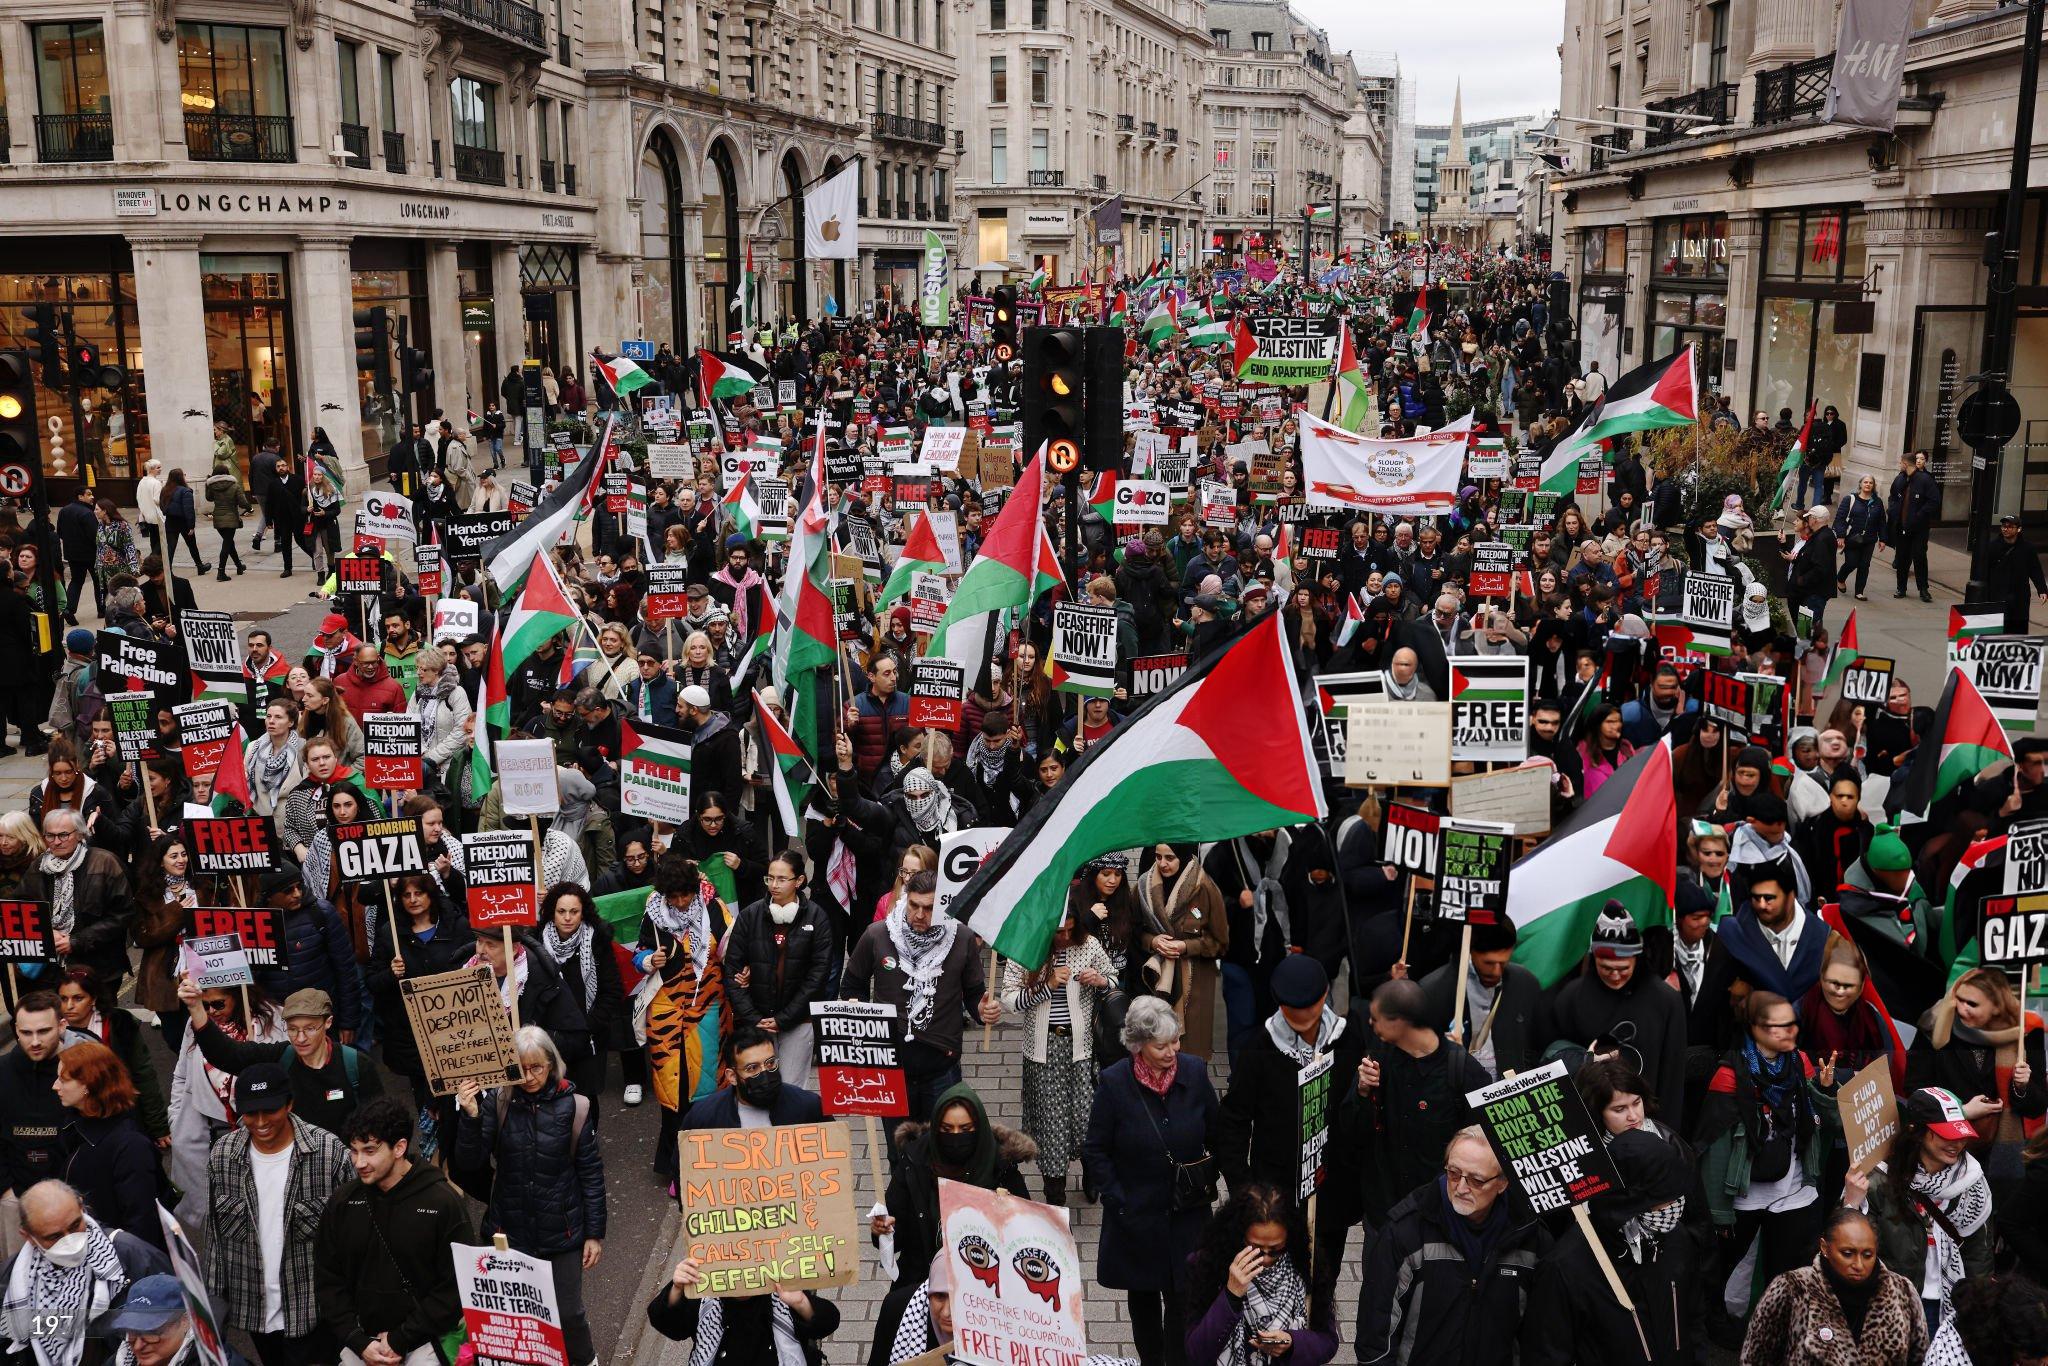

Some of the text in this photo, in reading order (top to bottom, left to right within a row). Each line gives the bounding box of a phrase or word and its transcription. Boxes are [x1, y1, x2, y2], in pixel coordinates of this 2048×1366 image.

[1840, 39, 1899, 81] H&M
[117, 191, 146, 199] HANOVER
[118, 199, 141, 207] STREET
[160, 194, 331, 212] LONGCHAMP
[400, 202, 450, 220] LONGCHAMP
[925, 247, 943, 324] UNISON
[1253, 318, 1326, 337] FREE
[1257, 338, 1329, 358] PALESTINE
[1250, 363, 1331, 378] END APARTHEID
[1177, 402, 1195, 411] Free
[880, 445, 910, 453] PALESTINE
[931, 440, 953, 448] IT BE
[848, 454, 862, 463] Off
[863, 460, 883, 469] FREEDOM
[983, 452, 1007, 463] Silence
[830, 465, 858, 474] Yemen
[606, 478, 627, 488] FREEDOM
[896, 484, 928, 499] FREE
[1392, 495, 1416, 503] POWER
[1116, 508, 1130, 516] Stop
[1278, 505, 1309, 522] GAZA
[368, 520, 380, 528] Stop
[447, 520, 511, 536] Hands Off
[1303, 528, 1339, 549] FREE
[1302, 548, 1338, 559] PALESTINE
[1476, 550, 1509, 560] FREEDOM
[340, 559, 382, 581] FREE
[650, 570, 683, 581] FREEDOM
[1473, 562, 1509, 572] PALESTINE
[341, 580, 382, 591] PALESTINE
[648, 583, 685, 594] PALESTINE
[1686, 579, 1733, 600] CEASEFIRE
[1689, 598, 1728, 622] NOW!
[183, 619, 236, 641] CEASEFIRE
[1056, 611, 1115, 636] CEASEFIRE
[119, 639, 157, 664] Free
[191, 638, 237, 664] NOW!
[1062, 629, 1109, 660] NOW!
[101, 653, 177, 686] Palestine
[916, 666, 959, 681] FREEDOM
[913, 683, 961, 699] PALESTINE
[111, 700, 150, 712] FROM THE
[181, 700, 220, 712] Socialist Worker
[113, 710, 148, 721] RIVER TO
[179, 708, 226, 728] FREEDOM
[1452, 702, 1524, 729] FREE
[116, 720, 147, 731] THE SEA
[368, 724, 415, 738] FREEDOM
[117, 729, 158, 741] PALESTINE
[181, 726, 231, 745] PALESTINE
[119, 739, 150, 750] WILL BE
[367, 742, 419, 756] PALESTINE
[121, 750, 141, 761] FREE
[376, 759, 410, 773] الحرية
[372, 772, 415, 784] لفلسطين
[623, 772, 688, 797] PALESTINE
[192, 818, 269, 855] FREE
[336, 819, 417, 840] STOP BOMBING
[472, 833, 523, 843] Socialist Worker
[199, 851, 272, 871] PALESTINE
[338, 833, 425, 878] GAZA
[469, 843, 528, 862] FREEDOM
[469, 866, 532, 886] PALESTINE
[481, 888, 524, 905] الحرية
[478, 904, 529, 921] لفلسطين
[193, 938, 231, 952] JUSTICE
[205, 957, 225, 968] NOT
[197, 971, 247, 986] GENOCIDE
[420, 984, 483, 1013] DO NOT
[823, 1004, 884, 1016] Socialist Worker
[426, 1005, 489, 1034] DESPAIR!
[820, 1017, 890, 1039] FREEDOM
[435, 1035, 494, 1057] FREE! FREE!
[439, 1051, 498, 1072] PALESTINE
[820, 1045, 898, 1067] PALESTINE
[837, 1071, 887, 1088] الحرية
[1481, 1071, 1552, 1101] Socialist Worker
[833, 1091, 896, 1106] لفلسطين
[1852, 1079, 1878, 1107] FUND
[1484, 1082, 1564, 1124] FROM THE
[1853, 1094, 1885, 1125] UNRWA
[1493, 1102, 1564, 1143] RIVER TO
[1863, 1113, 1881, 1137] NOT
[687, 1126, 848, 1171] ISRAEL
[1501, 1125, 1567, 1160] THE SEA
[1852, 1120, 1897, 1163] GENOCIDE
[1511, 1134, 1593, 1178] PALESTINE
[1519, 1159, 1584, 1196] WILL BE
[686, 1168, 841, 1208] MURDERS
[1528, 1190, 1570, 1214] FREE
[685, 1200, 798, 1238] CHILDREN
[688, 1238, 782, 1264] CALLS IT
[959, 1236, 997, 1257] CEASEFIRE
[970, 1250, 984, 1260] NOW
[486, 1263, 521, 1273] Party
[488, 1255, 534, 1271] Socialist
[1013, 1247, 1058, 1271] CEASEFIRE
[1026, 1264, 1043, 1274] NOW
[473, 1277, 543, 1304] END ISRAELI
[470, 1292, 552, 1322] STATE TERROR
[962, 1292, 1051, 1327] CEASEFIRE NOW
[489, 1314, 539, 1331] BUILD A NEW
[965, 1310, 1075, 1348] END THE OCCUPATION
[471, 1331, 478, 1342] A
[961, 1328, 1005, 1363] FREE
